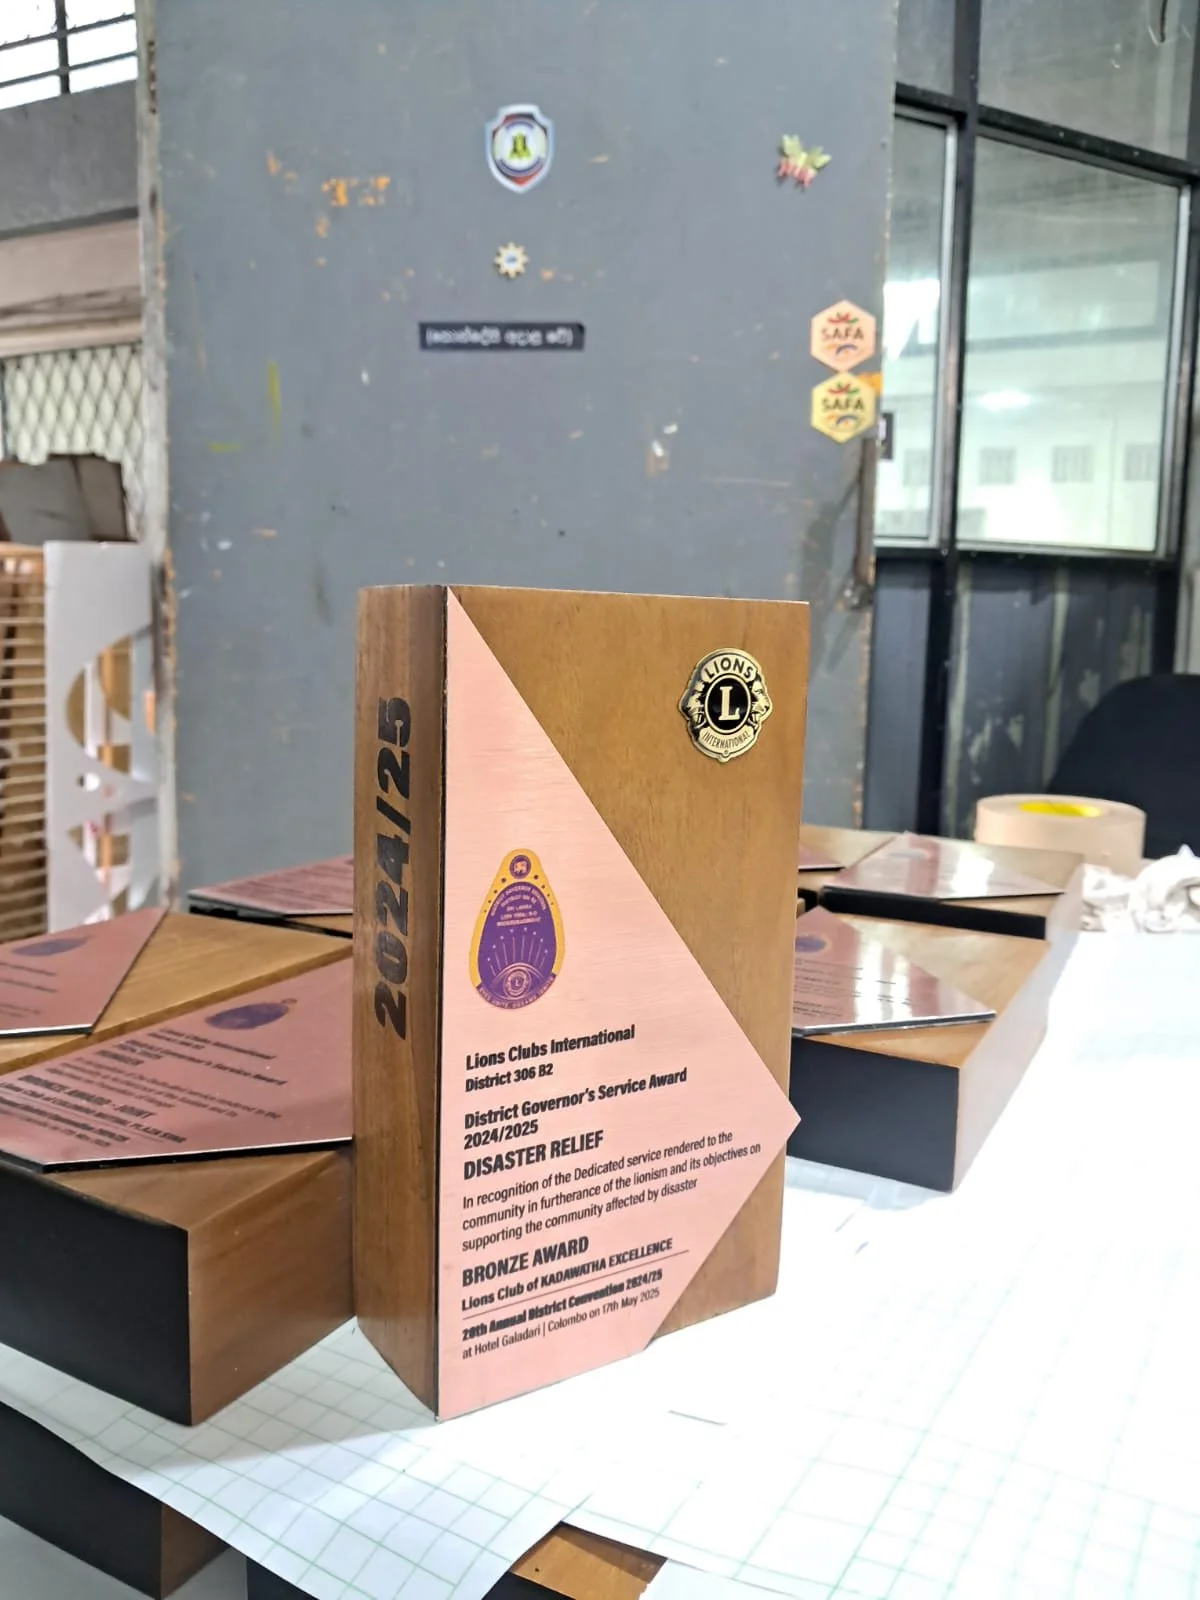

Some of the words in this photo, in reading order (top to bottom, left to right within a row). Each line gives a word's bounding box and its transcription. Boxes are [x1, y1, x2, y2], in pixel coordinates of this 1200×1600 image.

[822, 326, 864, 340] SAFA
[822, 397, 864, 410] SAFA
[704, 657, 753, 678] LIONS
[718, 686, 740, 720] L
[702, 730, 752, 748] INTERNATIONAL
[373, 696, 412, 1041] 2024/25
[466, 1050, 505, 1071] Lions
[508, 1041, 548, 1062] Clubs
[550, 1024, 636, 1054] International
[464, 1105, 518, 1129] District
[598, 1078, 646, 1100] Service
[649, 1067, 688, 1089] Award
[465, 1073, 511, 1092] District
[514, 1066, 536, 1083] 306
[538, 1063, 554, 1077] B2
[464, 1119, 539, 1150] 2024/2025
[464, 1143, 547, 1180] DISASTER
[550, 1130, 604, 1159] RELIEF
[462, 1203, 525, 1231] community
[528, 1200, 538, 1213] in
[540, 1186, 600, 1210] furtherance
[603, 1179, 614, 1193] of
[615, 1176, 631, 1190] the
[633, 1167, 668, 1185] lionism
[670, 1162, 687, 1176] and
[690, 1158, 701, 1172] its
[703, 1146, 748, 1168] objectives
[750, 1143, 761, 1155] on
[463, 1196, 474, 1209] In
[477, 1181, 539, 1204] recognition
[542, 1174, 553, 1189] of
[555, 1172, 571, 1186] the
[574, 1157, 625, 1181] Dedicated
[627, 1150, 661, 1168] service
[664, 1137, 705, 1159] rendered
[707, 1136, 717, 1147] to
[718, 1130, 733, 1144] the
[462, 1226, 522, 1252] supporting
[525, 1220, 543, 1234] the
[545, 1202, 603, 1229] community
[605, 1193, 645, 1213] affected
[647, 1188, 659, 1203] by
[661, 1178, 698, 1197] disaster
[462, 1252, 529, 1287] BRONZE
[532, 1236, 589, 1266] AWARD
[462, 1293, 495, 1311] Lions
[497, 1282, 524, 1300] Club
[526, 1277, 539, 1292] of
[541, 1258, 606, 1288] KADAWATHA
[608, 1237, 673, 1267] EXCELLENCE
[462, 1347, 472, 1360] at
[474, 1337, 500, 1356] Hotel
[501, 1323, 540, 1347] Galadari
[548, 1312, 587, 1332] Colombo
[589, 1308, 600, 1319] on
[602, 1300, 619, 1314] 17th
[621, 1295, 638, 1309] May
[640, 1287, 660, 1303] 2025
[489, 1309, 527, 1333] Annual
[528, 1298, 567, 1321] District
[568, 1282, 624, 1308] Convention
[626, 1268, 663, 1290] 2024/25
